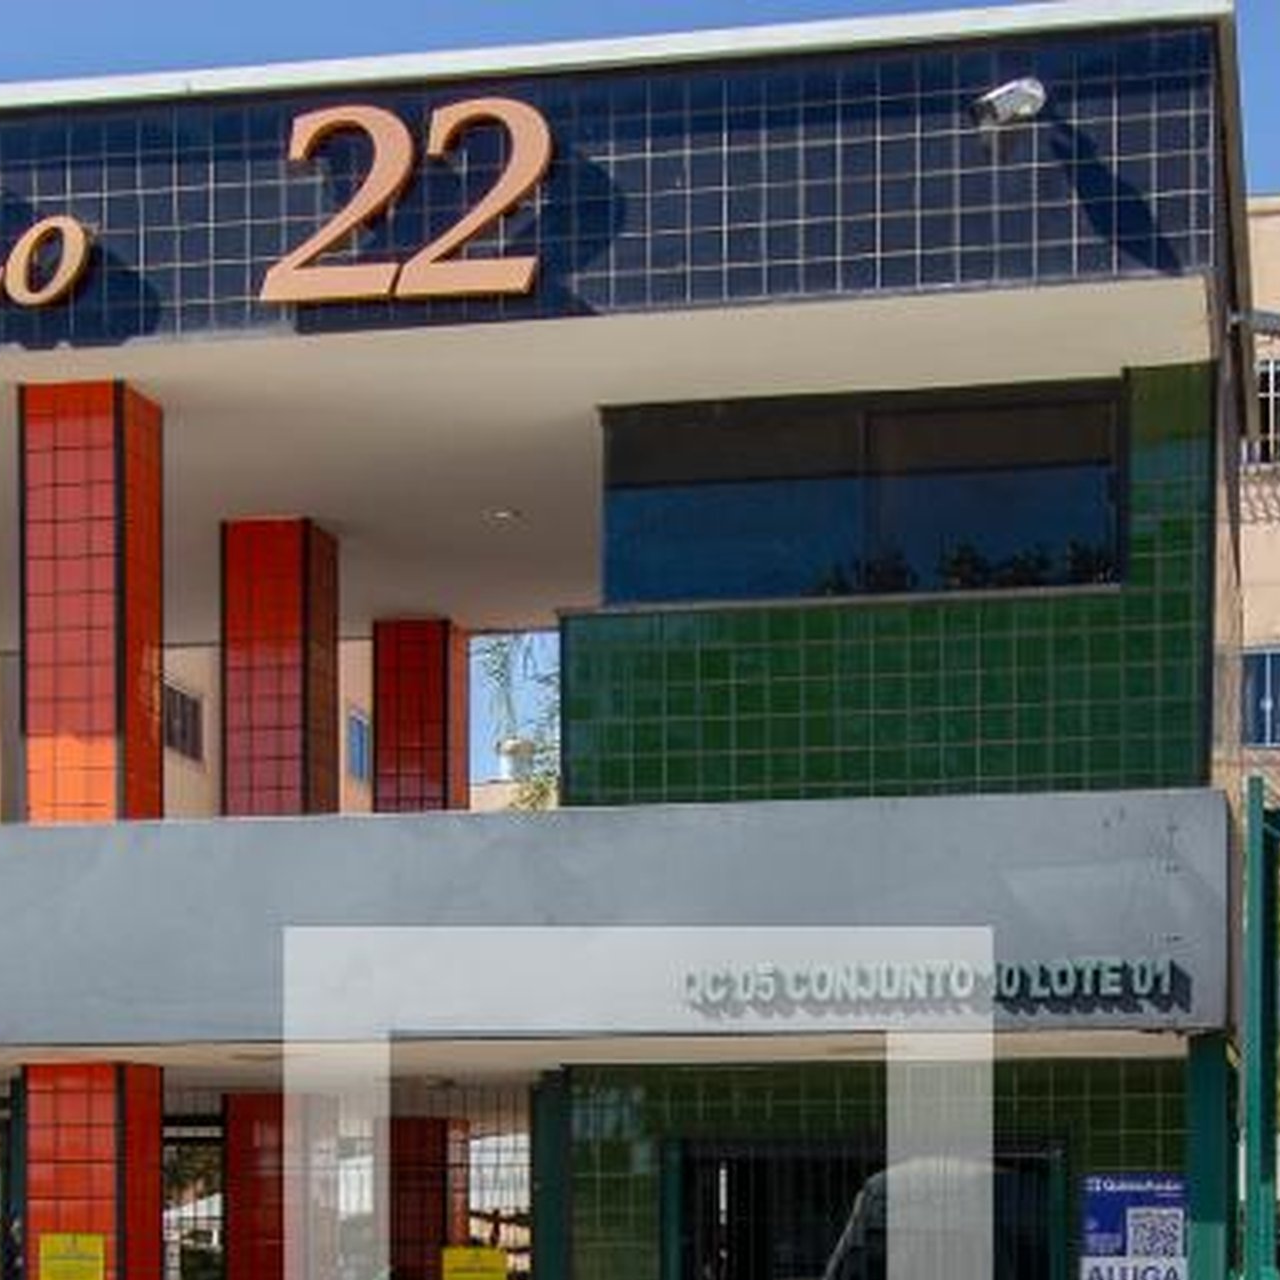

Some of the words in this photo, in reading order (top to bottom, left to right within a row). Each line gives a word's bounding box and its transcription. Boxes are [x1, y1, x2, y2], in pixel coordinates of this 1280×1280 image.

[260, 98, 553, 303] 22
[734, 959, 776, 1001] 05
[783, 959, 976, 1000] CONJUNTO
[1029, 959, 1121, 998] LOTE
[1132, 958, 1174, 995] 01
